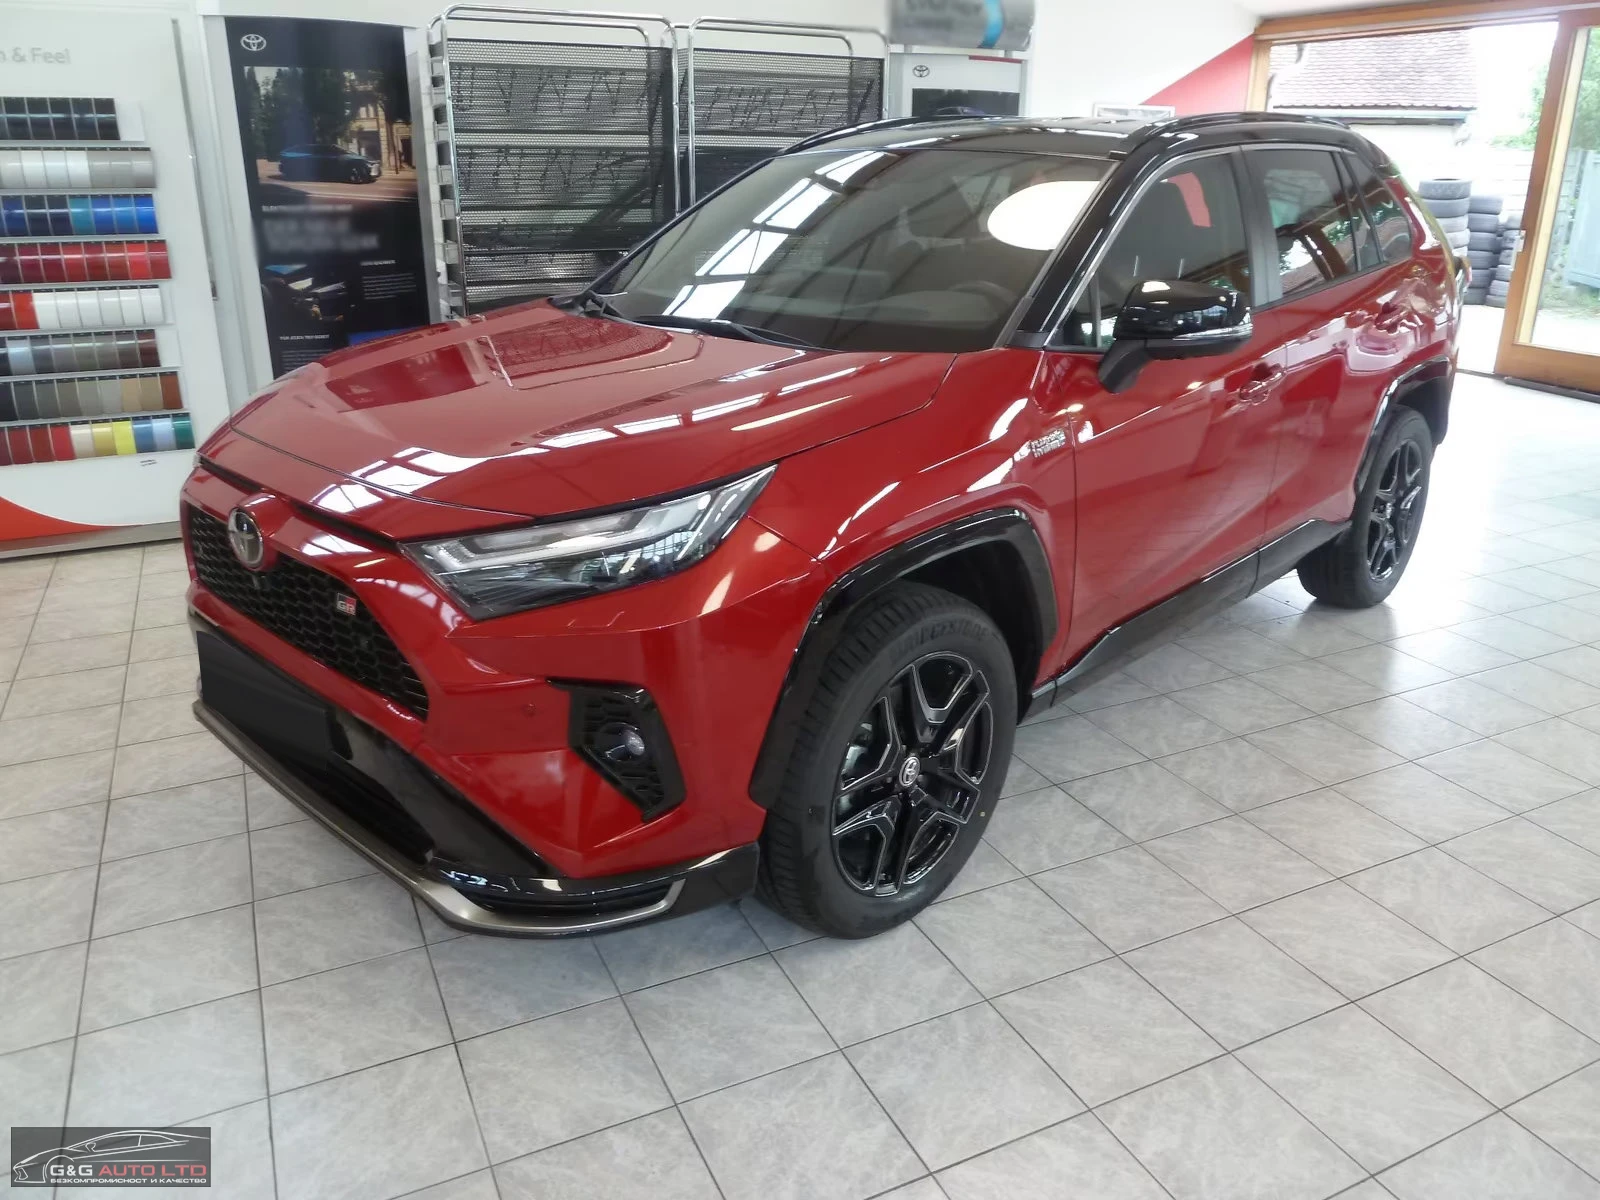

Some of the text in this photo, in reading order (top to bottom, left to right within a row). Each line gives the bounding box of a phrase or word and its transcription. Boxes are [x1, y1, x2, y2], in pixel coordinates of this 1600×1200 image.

[12, 46, 27, 63] &
[31, 47, 72, 64] Feel
[336, 600, 356, 616] GR
